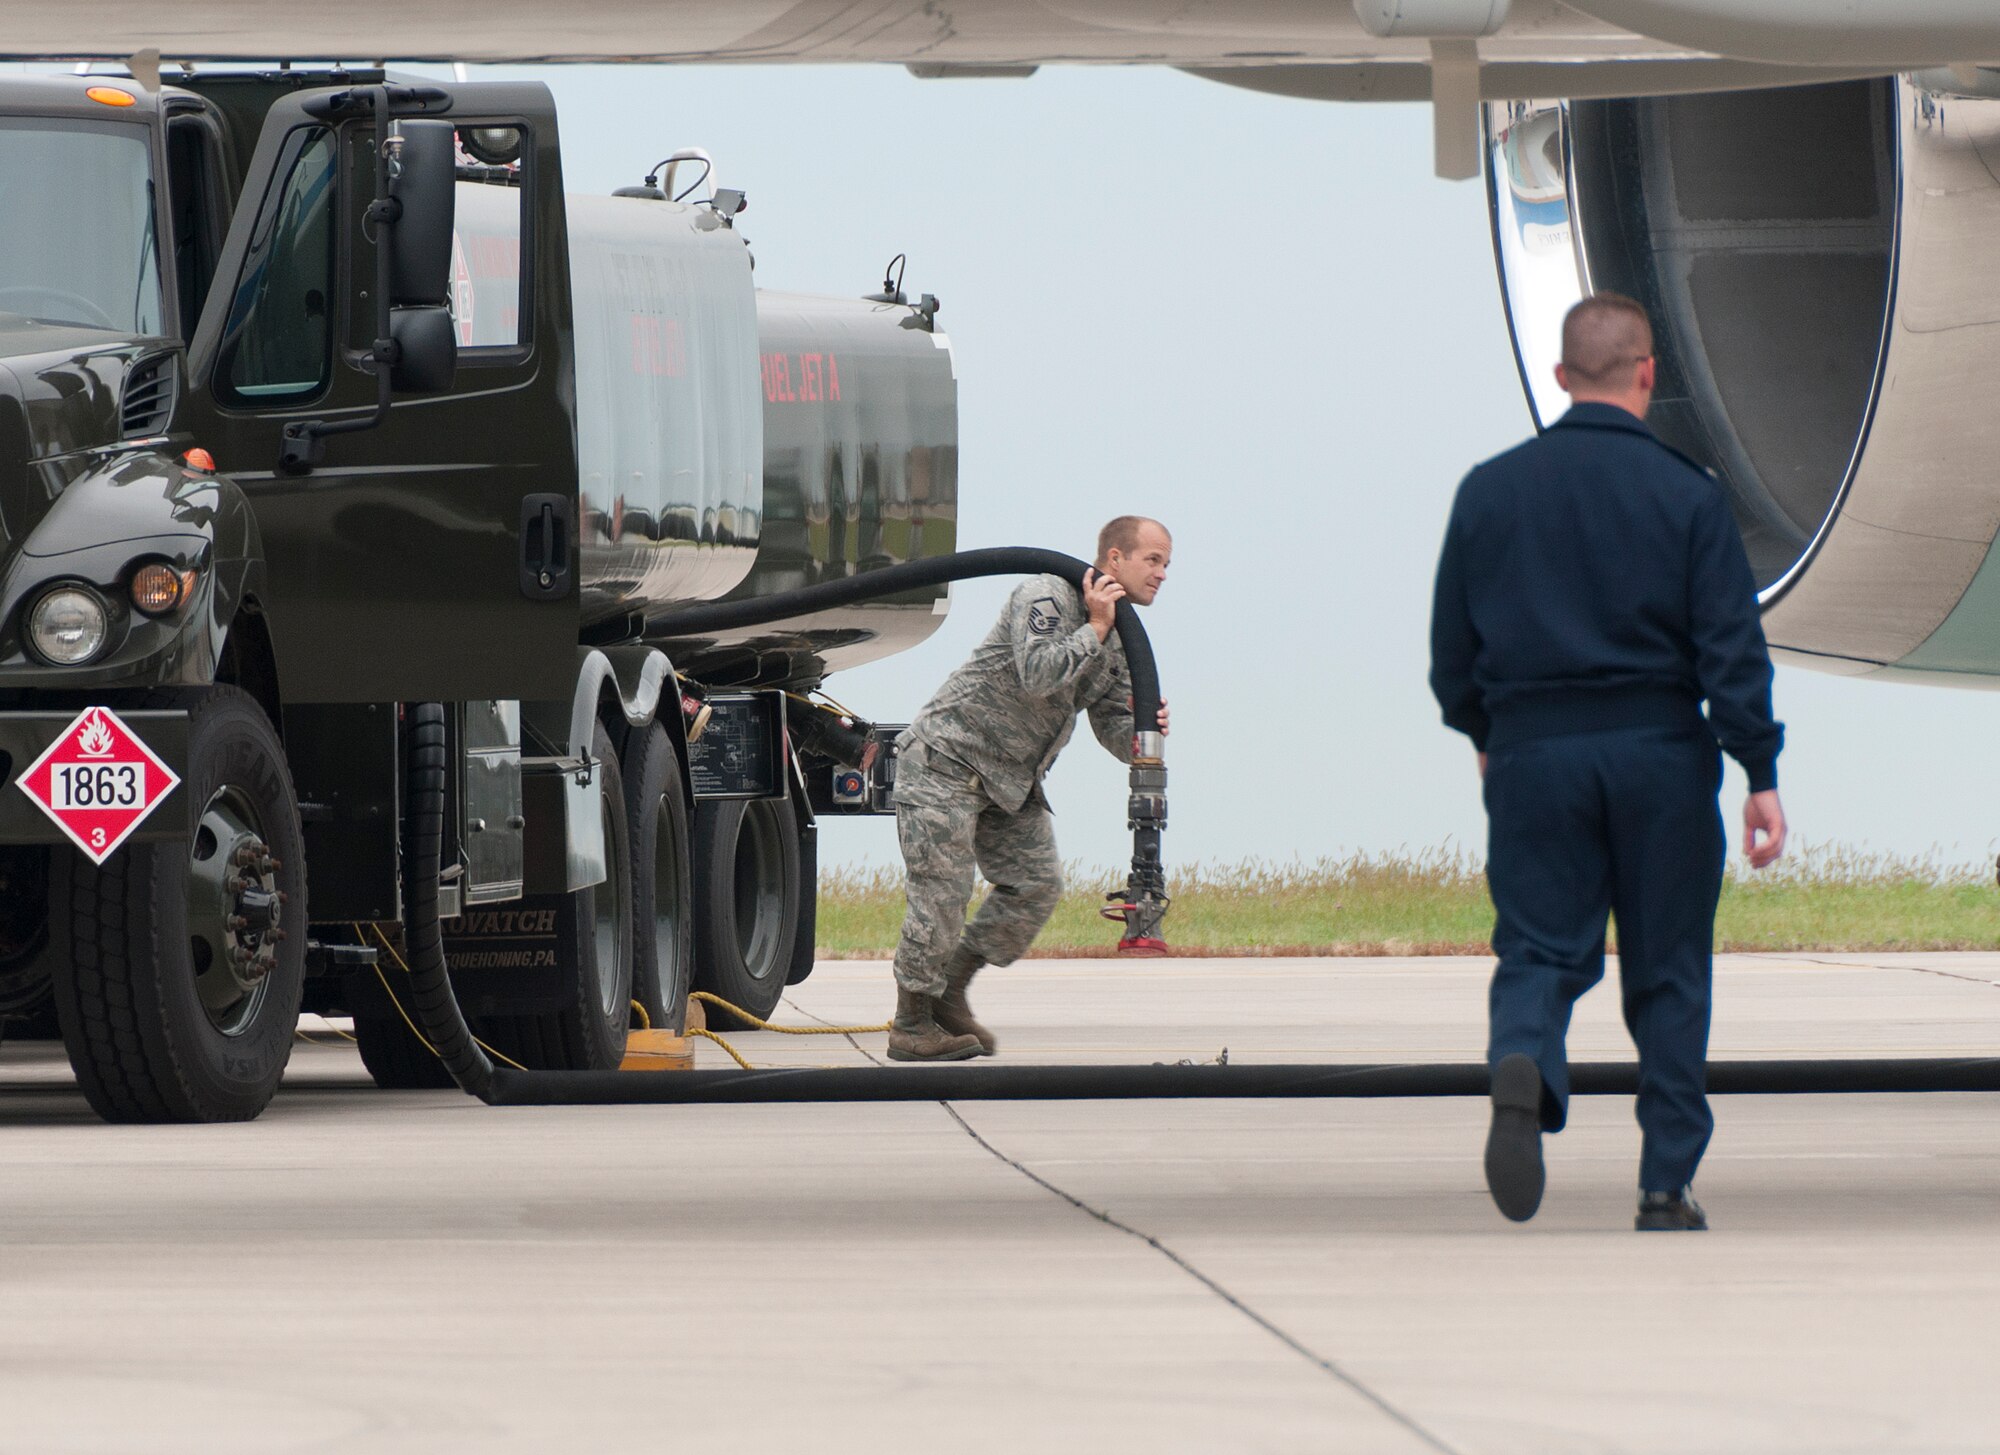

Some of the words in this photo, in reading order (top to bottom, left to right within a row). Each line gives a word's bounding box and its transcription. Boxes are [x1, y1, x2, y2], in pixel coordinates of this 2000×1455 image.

[799, 352, 823, 401] JET
[829, 352, 841, 401] A
[59, 766, 137, 806] 1863
[91, 827, 106, 848] 3
[441, 910, 557, 935] OVATCH
